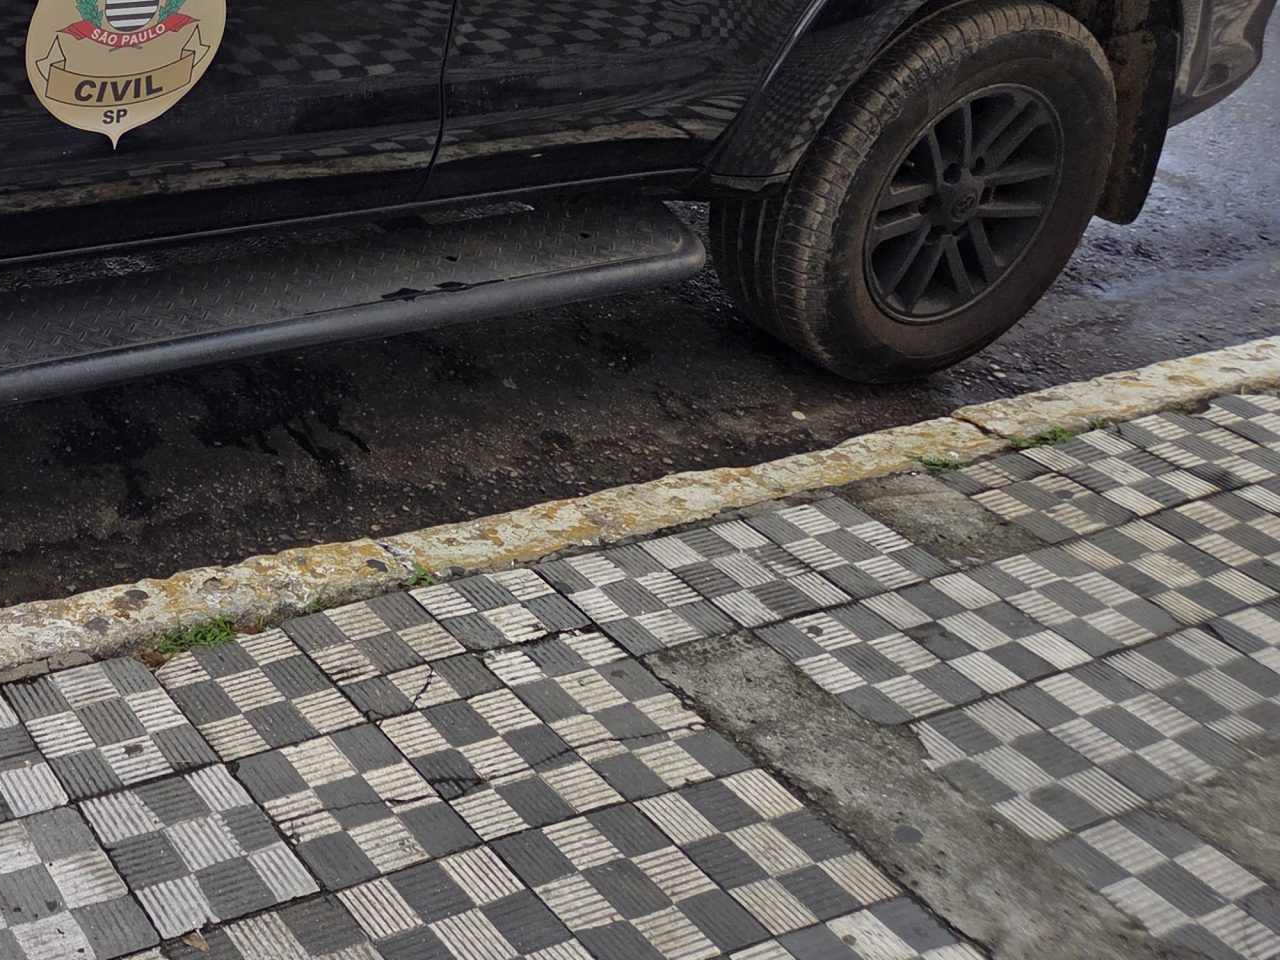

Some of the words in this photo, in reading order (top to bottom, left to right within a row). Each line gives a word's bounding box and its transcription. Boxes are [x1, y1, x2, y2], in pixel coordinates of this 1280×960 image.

[121, 23, 166, 46] PAULO
[74, 74, 163, 103] CIVIL
[102, 108, 128, 125] SP
